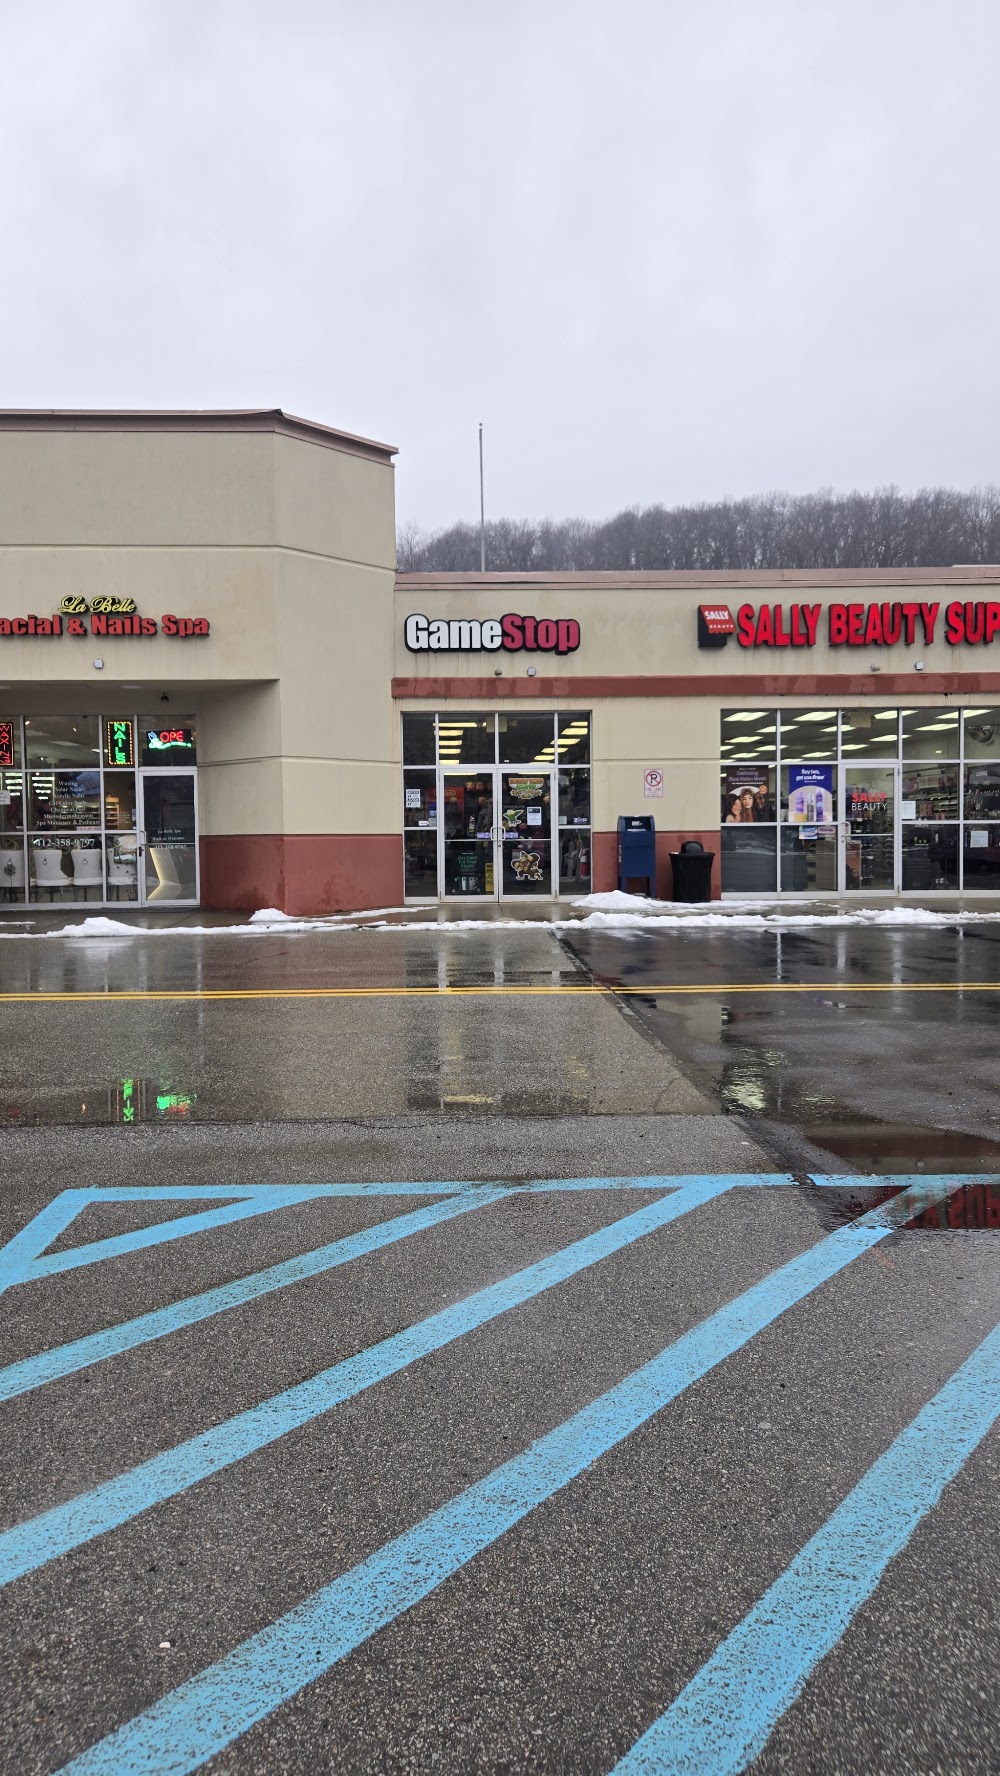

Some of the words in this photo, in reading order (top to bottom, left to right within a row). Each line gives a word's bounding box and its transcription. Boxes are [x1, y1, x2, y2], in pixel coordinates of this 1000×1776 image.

[58, 595, 88, 614] La
[90, 595, 137, 614] Belle
[67, 617, 87, 636] &
[91, 615, 157, 636] Nails
[162, 614, 210, 638] Spa
[704, 611, 729, 620] SALLY
[737, 603, 822, 648] SALLY
[829, 602, 940, 646] BEAUTY
[945, 600, 1000, 646] SUP
[404, 613, 580, 656] GameStop
[114, 723, 126, 763] NAILS
[851, 792, 887, 802] SALLY
[851, 802, 888, 811] BEAUTY
